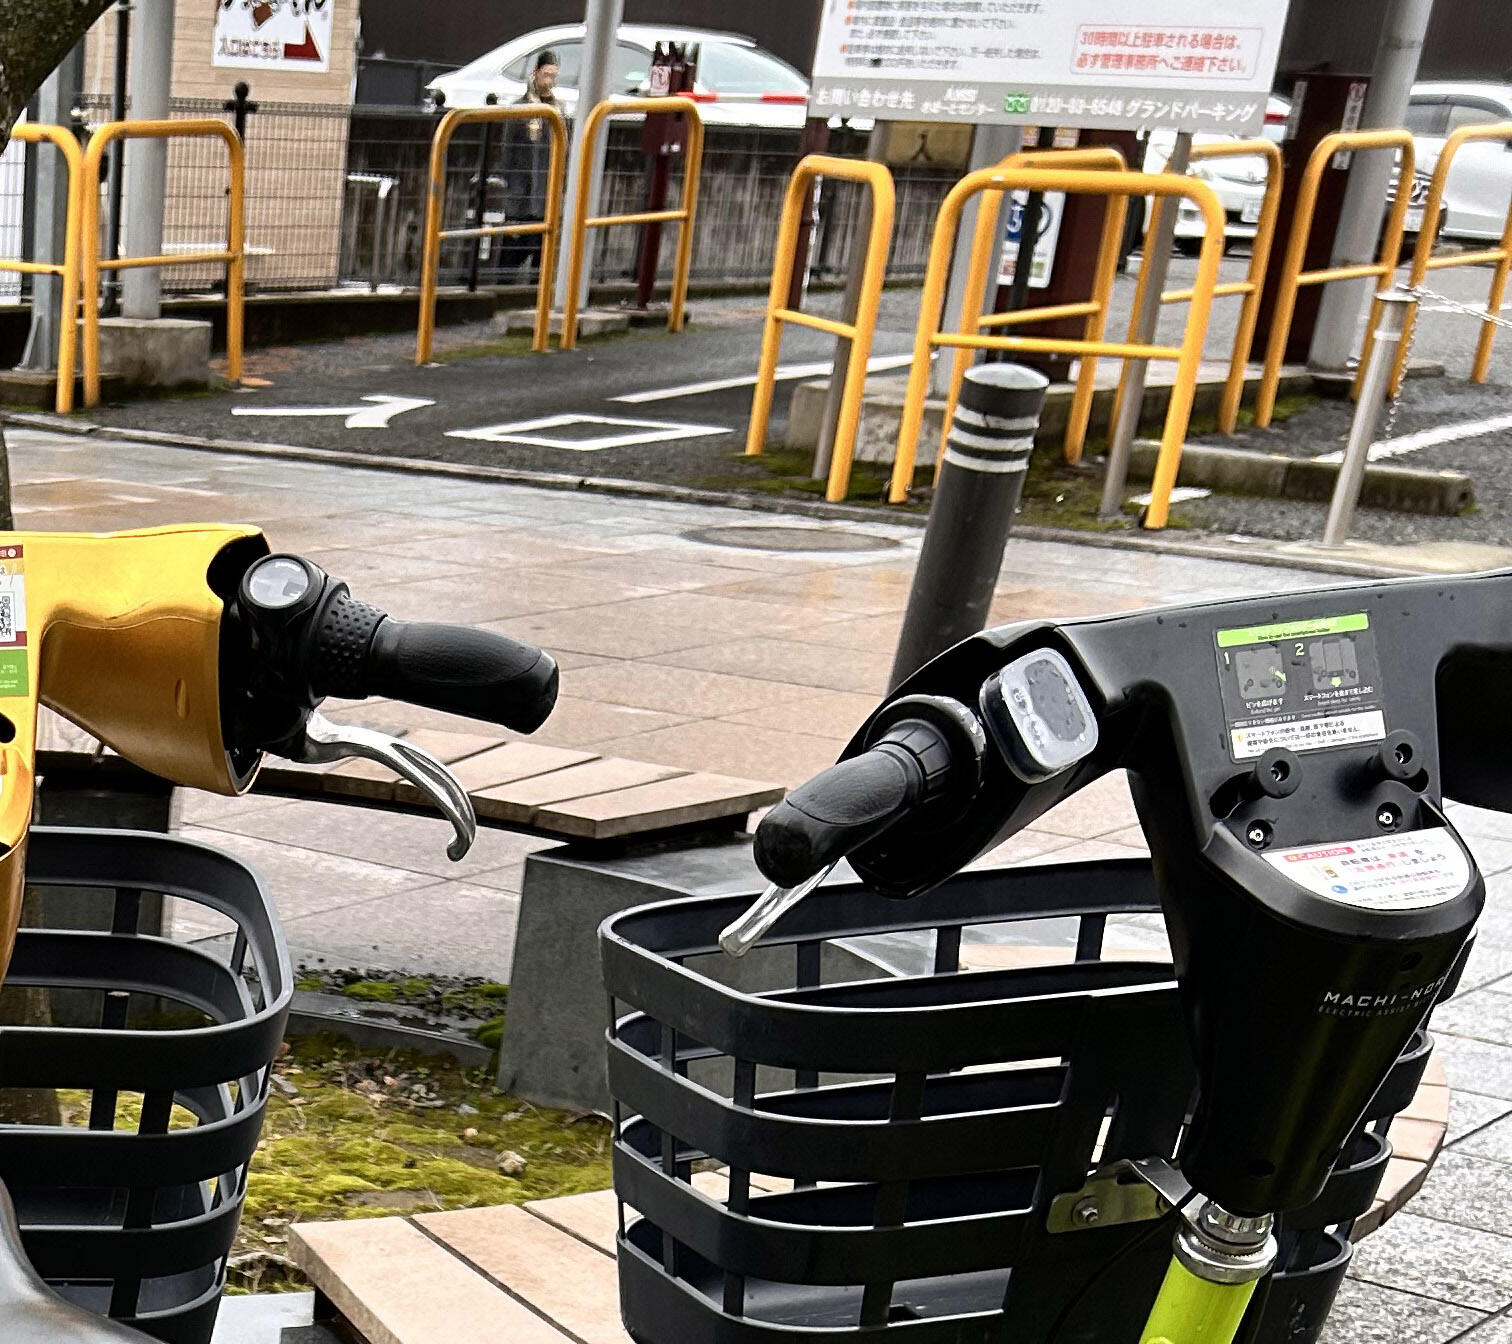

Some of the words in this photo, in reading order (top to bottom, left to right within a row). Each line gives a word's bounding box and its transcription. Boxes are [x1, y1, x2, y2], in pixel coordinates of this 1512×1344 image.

[1125, 98, 1258, 122] グランドパーキング
[1224, 652, 1230, 665] 1
[1294, 643, 1305, 657] 2
[1323, 976, 1446, 1007] MACHI-NOR
